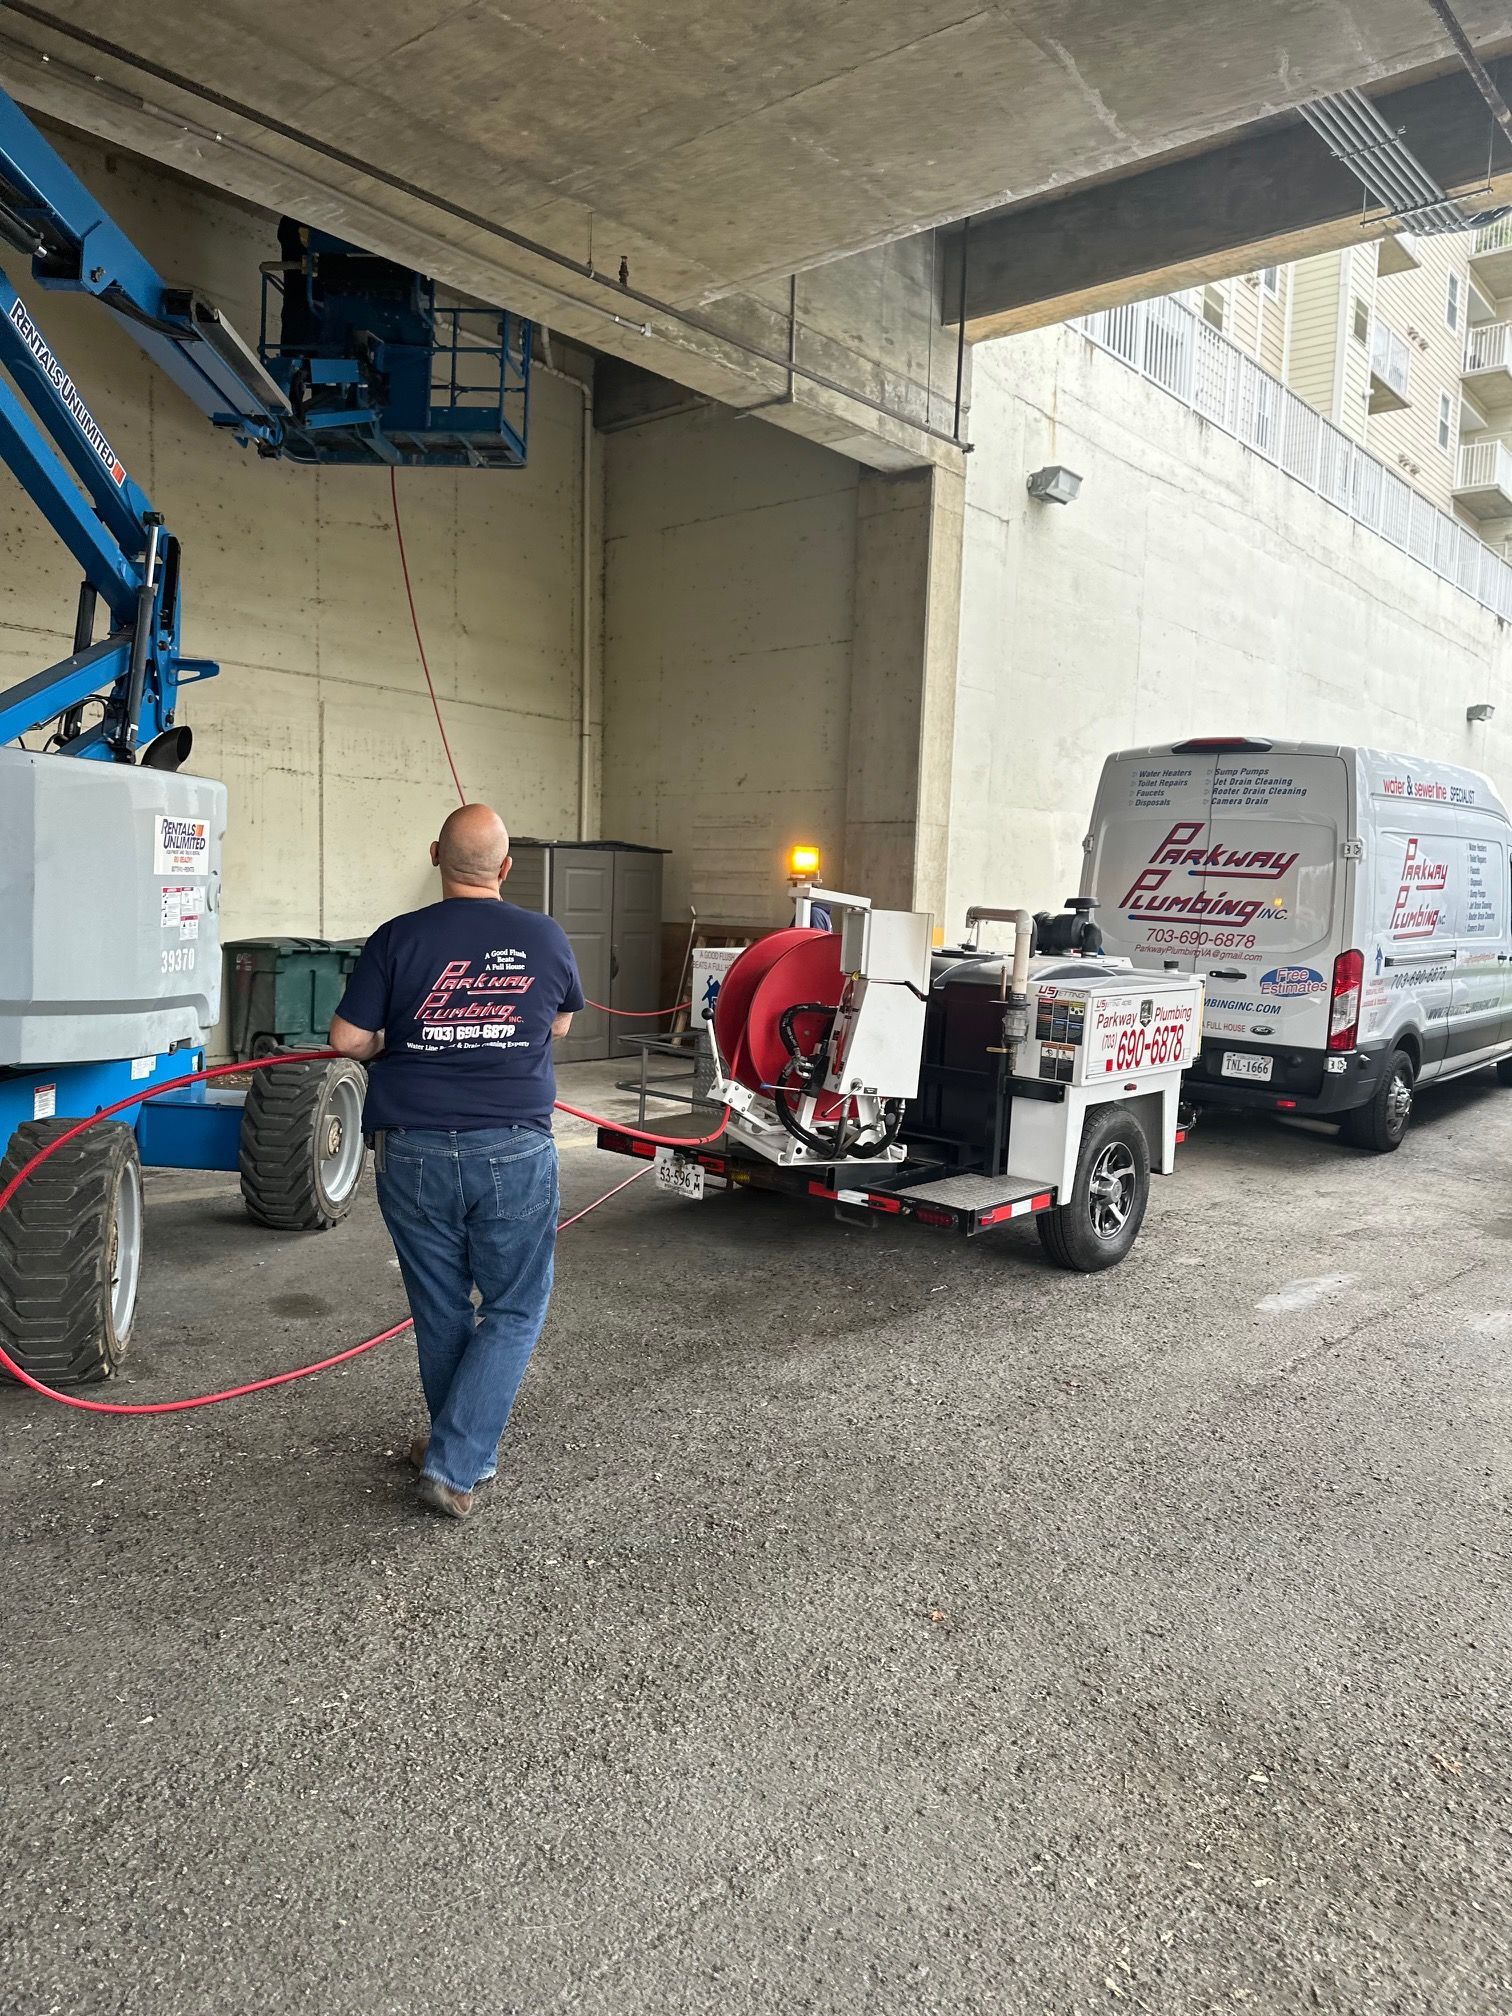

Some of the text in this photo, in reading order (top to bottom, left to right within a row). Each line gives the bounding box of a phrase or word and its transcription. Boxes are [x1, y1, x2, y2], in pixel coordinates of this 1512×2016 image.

[10, 298, 117, 470] RENTALS UNLIMITED
[1214, 768, 1269, 776] Sump Pumps
[1159, 779, 1188, 788] Repairs
[1213, 778, 1227, 786] Jet
[1255, 778, 1293, 786] Cleaning
[1136, 789, 1165, 797] Faucets
[1268, 787, 1307, 796] Cleaning
[1383, 777, 1405, 794] water
[1407, 775, 1413, 796] &
[1450, 786, 1475, 804] SPECIALIST
[1135, 799, 1170, 807] Disposals
[160, 819, 196, 836] RENTALS
[163, 835, 206, 850] UNLIMITED
[1257, 908, 1288, 920] INC.
[1146, 928, 1256, 949] 703-690-6878
[484, 949, 527, 960] A Good Flush
[705, 951, 719, 959] GOOD
[720, 952, 736, 961] FLUSH
[1135, 944, 1263, 962] ParkwayPlumbingVA@gmail.com
[161, 948, 195, 973] 39370
[692, 961, 707, 969] BEATS
[713, 962, 724, 971] FULL
[1276, 968, 1310, 982] Free
[1261, 981, 1328, 995] Estimates
[1096, 1006, 1192, 1030] Parkway Plumbing
[422, 1024, 516, 1042] (703) 690-6878
[1207, 1021, 1222, 1030] FULL
[1224, 1023, 1246, 1033] HOUSE
[406, 1042, 425, 1050] Water
[425, 1043, 438, 1051] Line
[1102, 1024, 1184, 1071] (703) 690-6878
[1226, 1059, 1269, 1075] TNL-1666
[660, 1167, 691, 1187] 53-596
